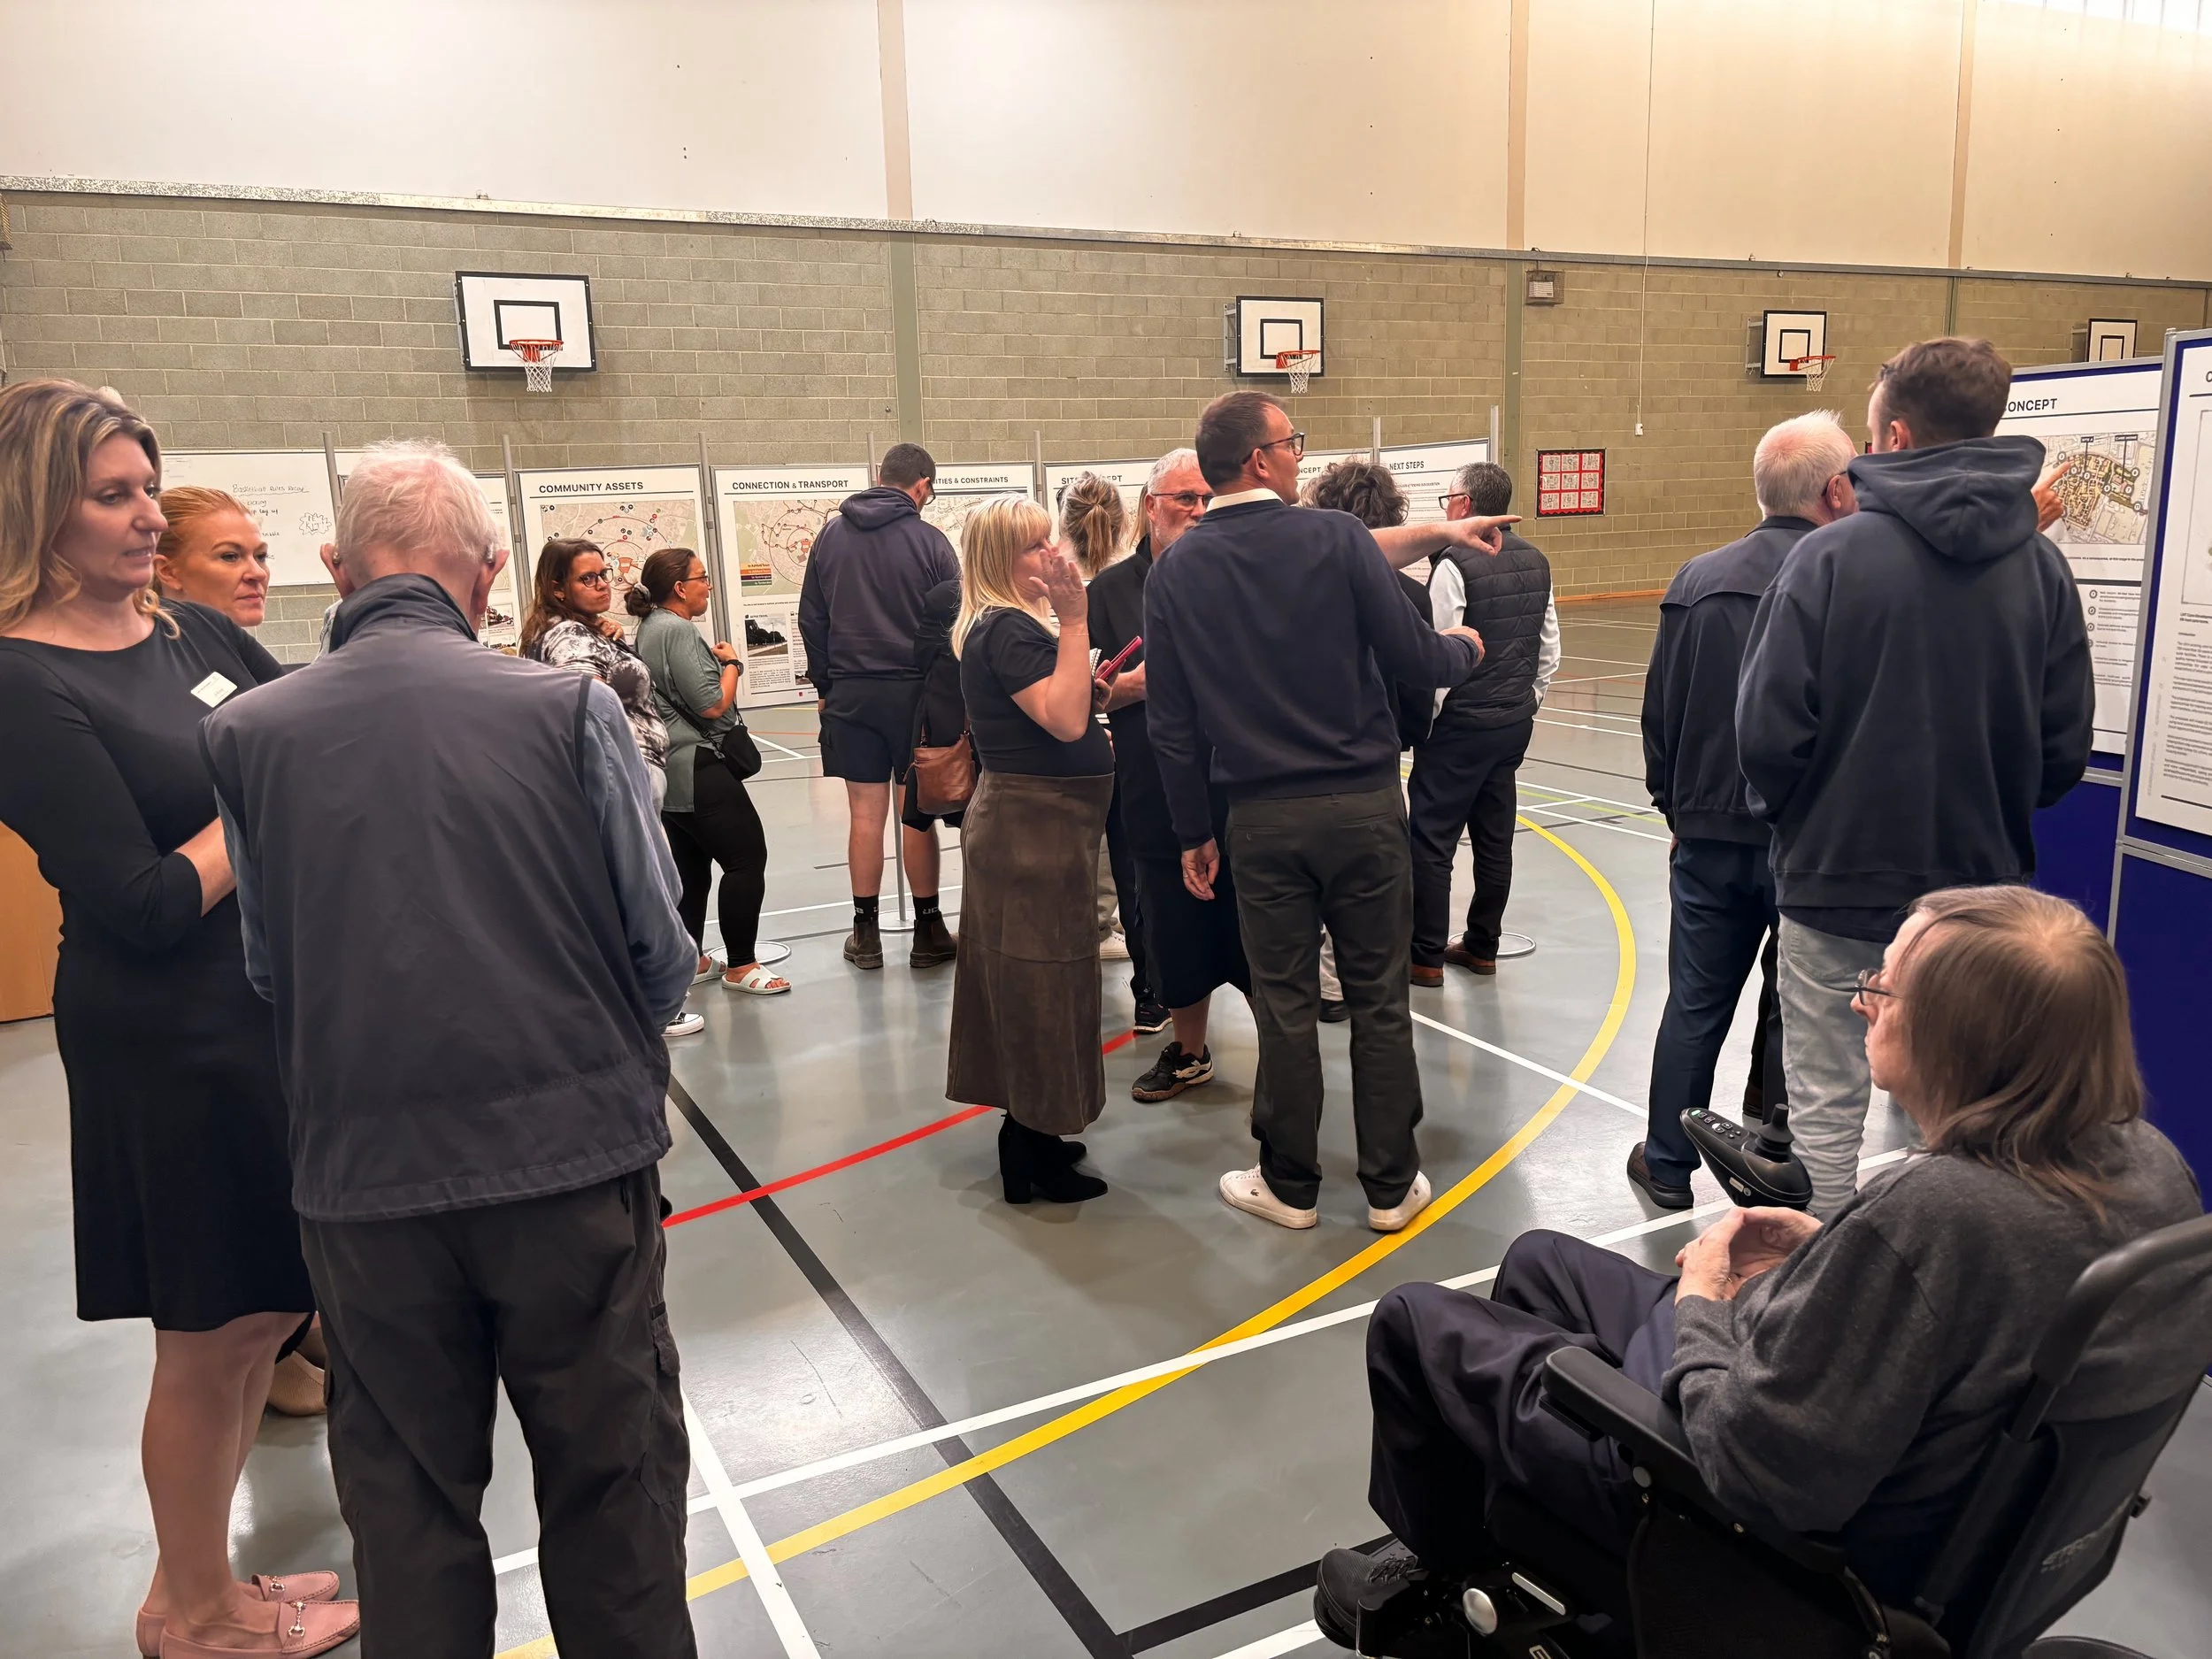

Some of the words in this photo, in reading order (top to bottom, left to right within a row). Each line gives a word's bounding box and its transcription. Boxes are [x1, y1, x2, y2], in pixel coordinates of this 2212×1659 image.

[2006, 398, 2057, 412] ONCEPT
[1389, 462, 1404, 471] NEXT
[1406, 461, 1425, 470] STEPS
[539, 483, 603, 493] COMMUNITY
[605, 481, 644, 491] ASSETS
[798, 480, 849, 488] TRANSPORT
